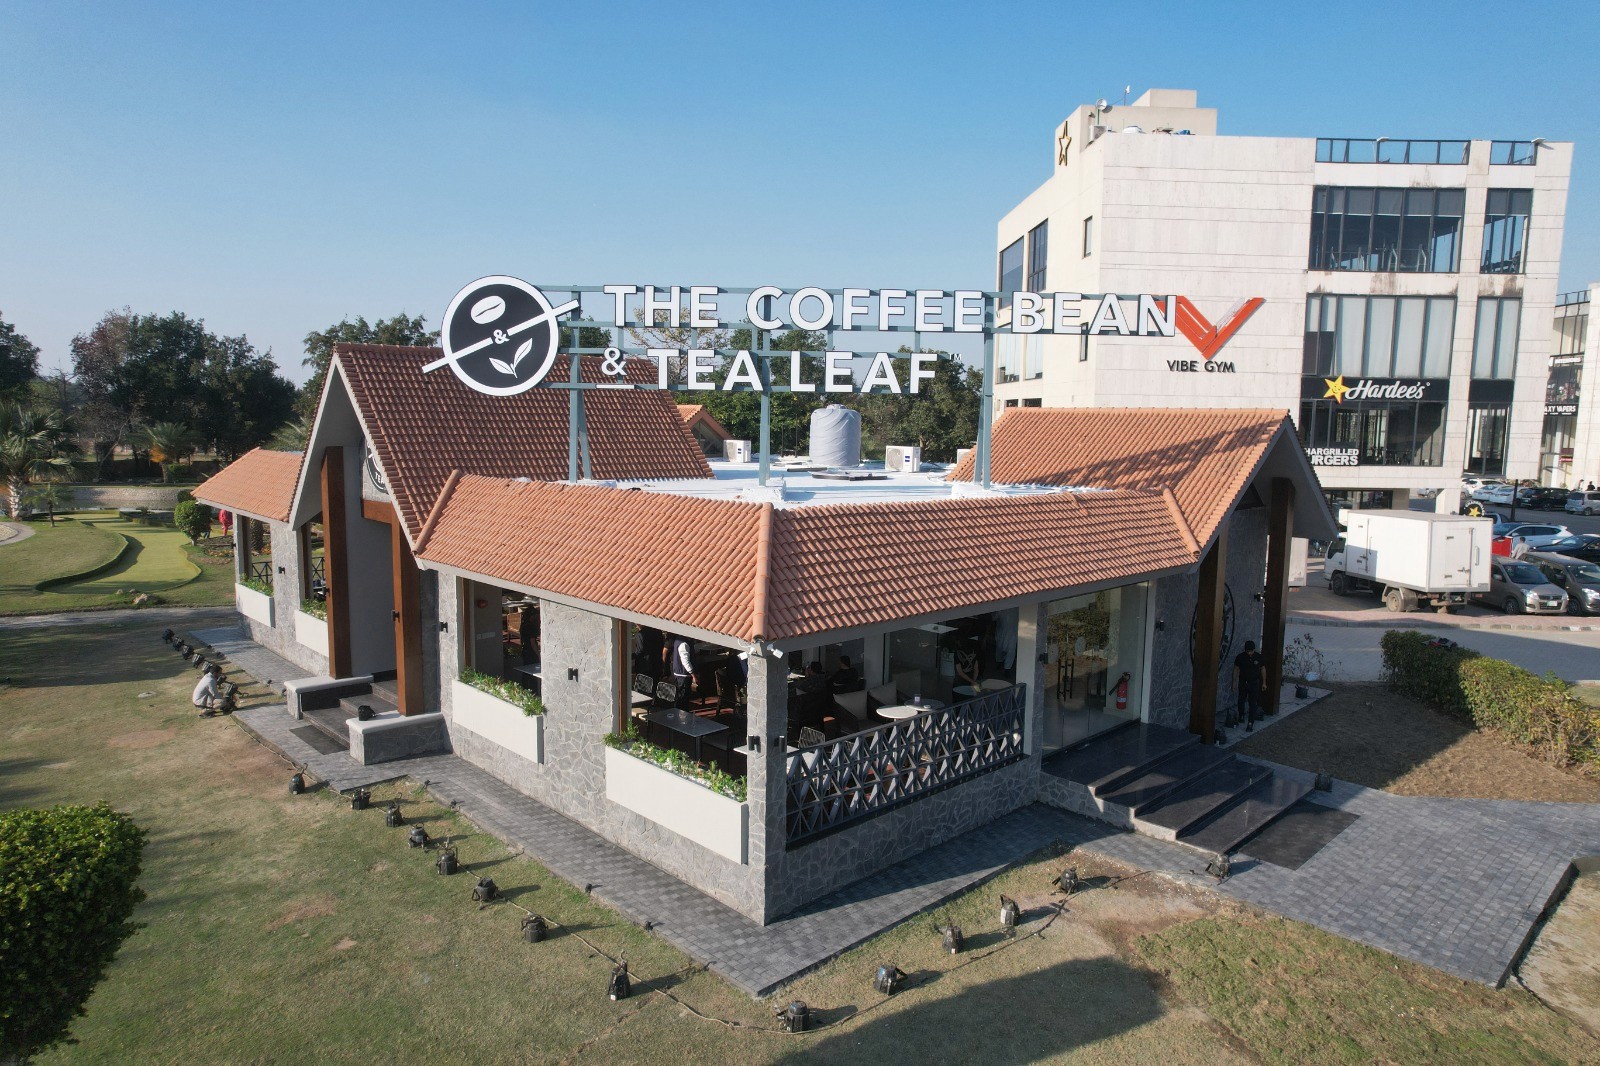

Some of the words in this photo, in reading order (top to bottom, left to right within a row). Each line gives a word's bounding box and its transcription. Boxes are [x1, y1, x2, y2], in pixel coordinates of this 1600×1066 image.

[603, 284, 720, 328] THE
[746, 285, 984, 334] COFFEE
[1011, 290, 1177, 337] BEAN
[601, 347, 627, 376] &
[647, 348, 764, 391] TEA
[790, 350, 938, 393] LEAF
[1166, 360, 1199, 372] VIBE
[1204, 360, 1236, 373] GYM
[1544, 405, 1556, 413] AXY
[1304, 447, 1360, 456] HARGRILLED
